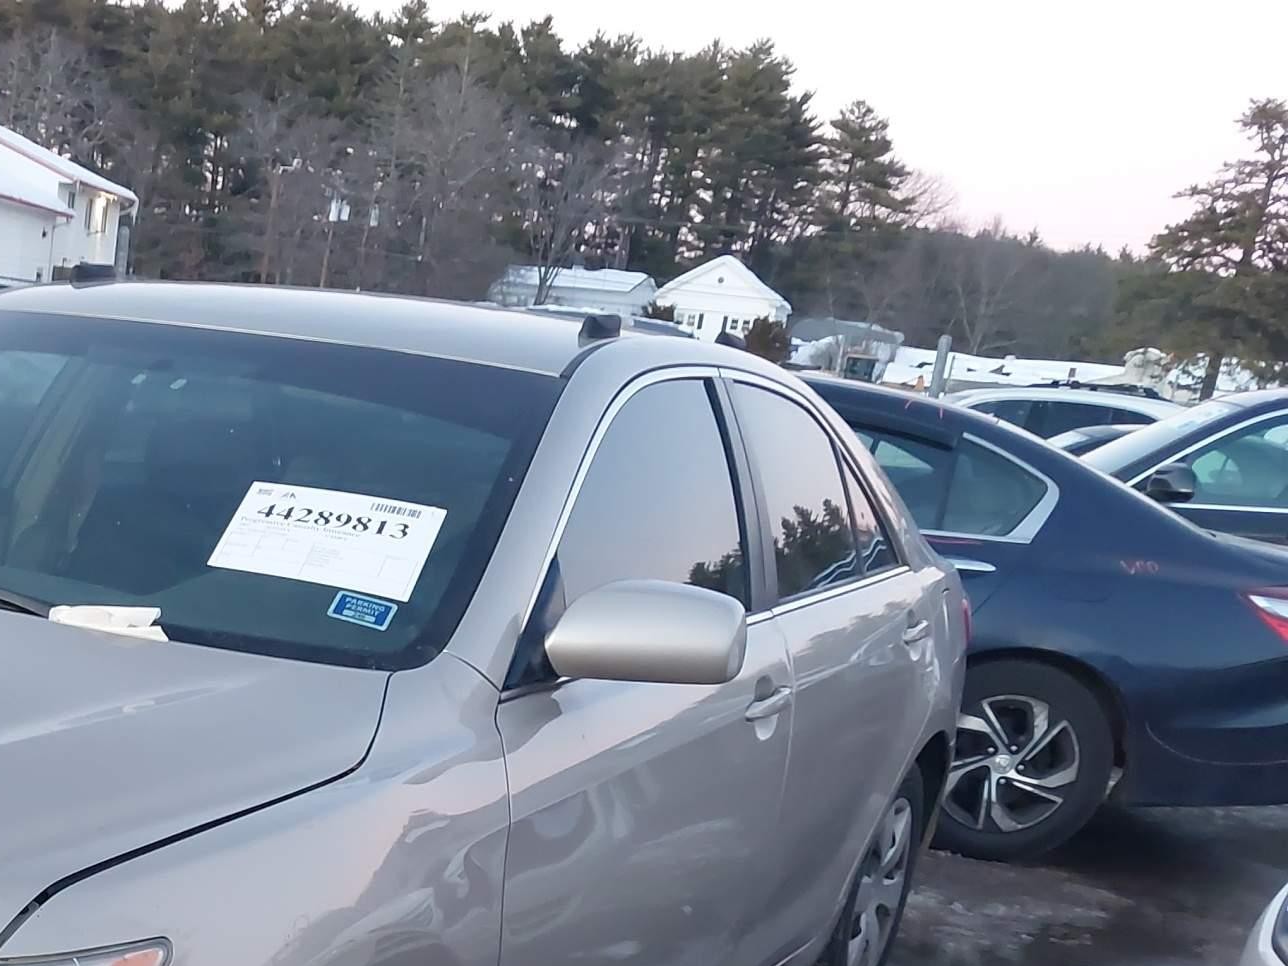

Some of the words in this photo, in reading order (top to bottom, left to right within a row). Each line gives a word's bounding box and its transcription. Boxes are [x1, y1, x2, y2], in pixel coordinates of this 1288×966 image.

[257, 503, 410, 540] 44289813
[345, 603, 380, 616] PERMIT
[346, 597, 385, 612] PARKING
